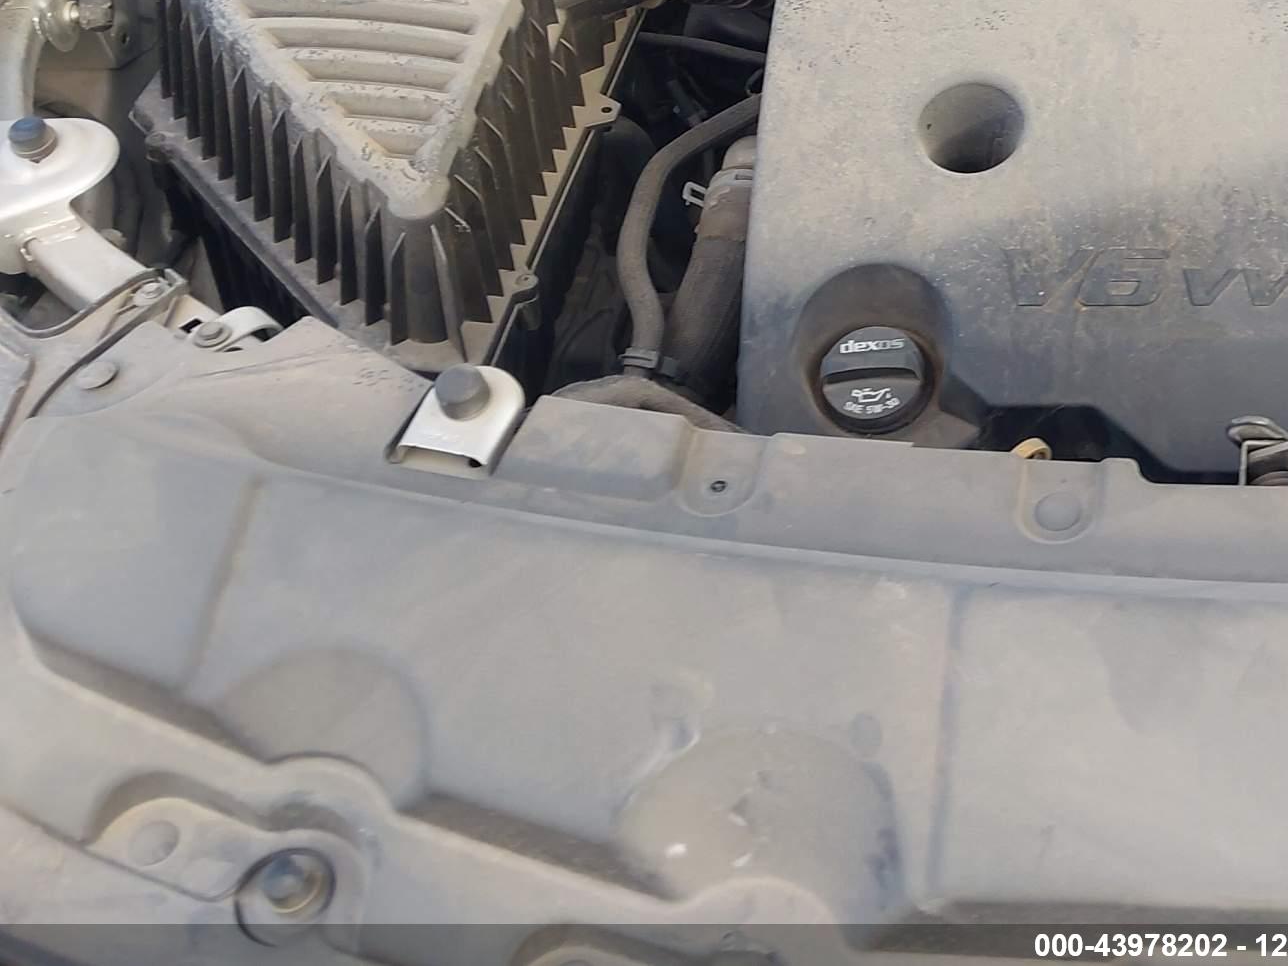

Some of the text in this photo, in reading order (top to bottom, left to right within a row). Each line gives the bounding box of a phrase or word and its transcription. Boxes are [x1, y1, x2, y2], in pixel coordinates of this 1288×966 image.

[1001, 247, 1171, 308] V6
[839, 338, 905, 354] dexos
[843, 401, 865, 414] SAE
